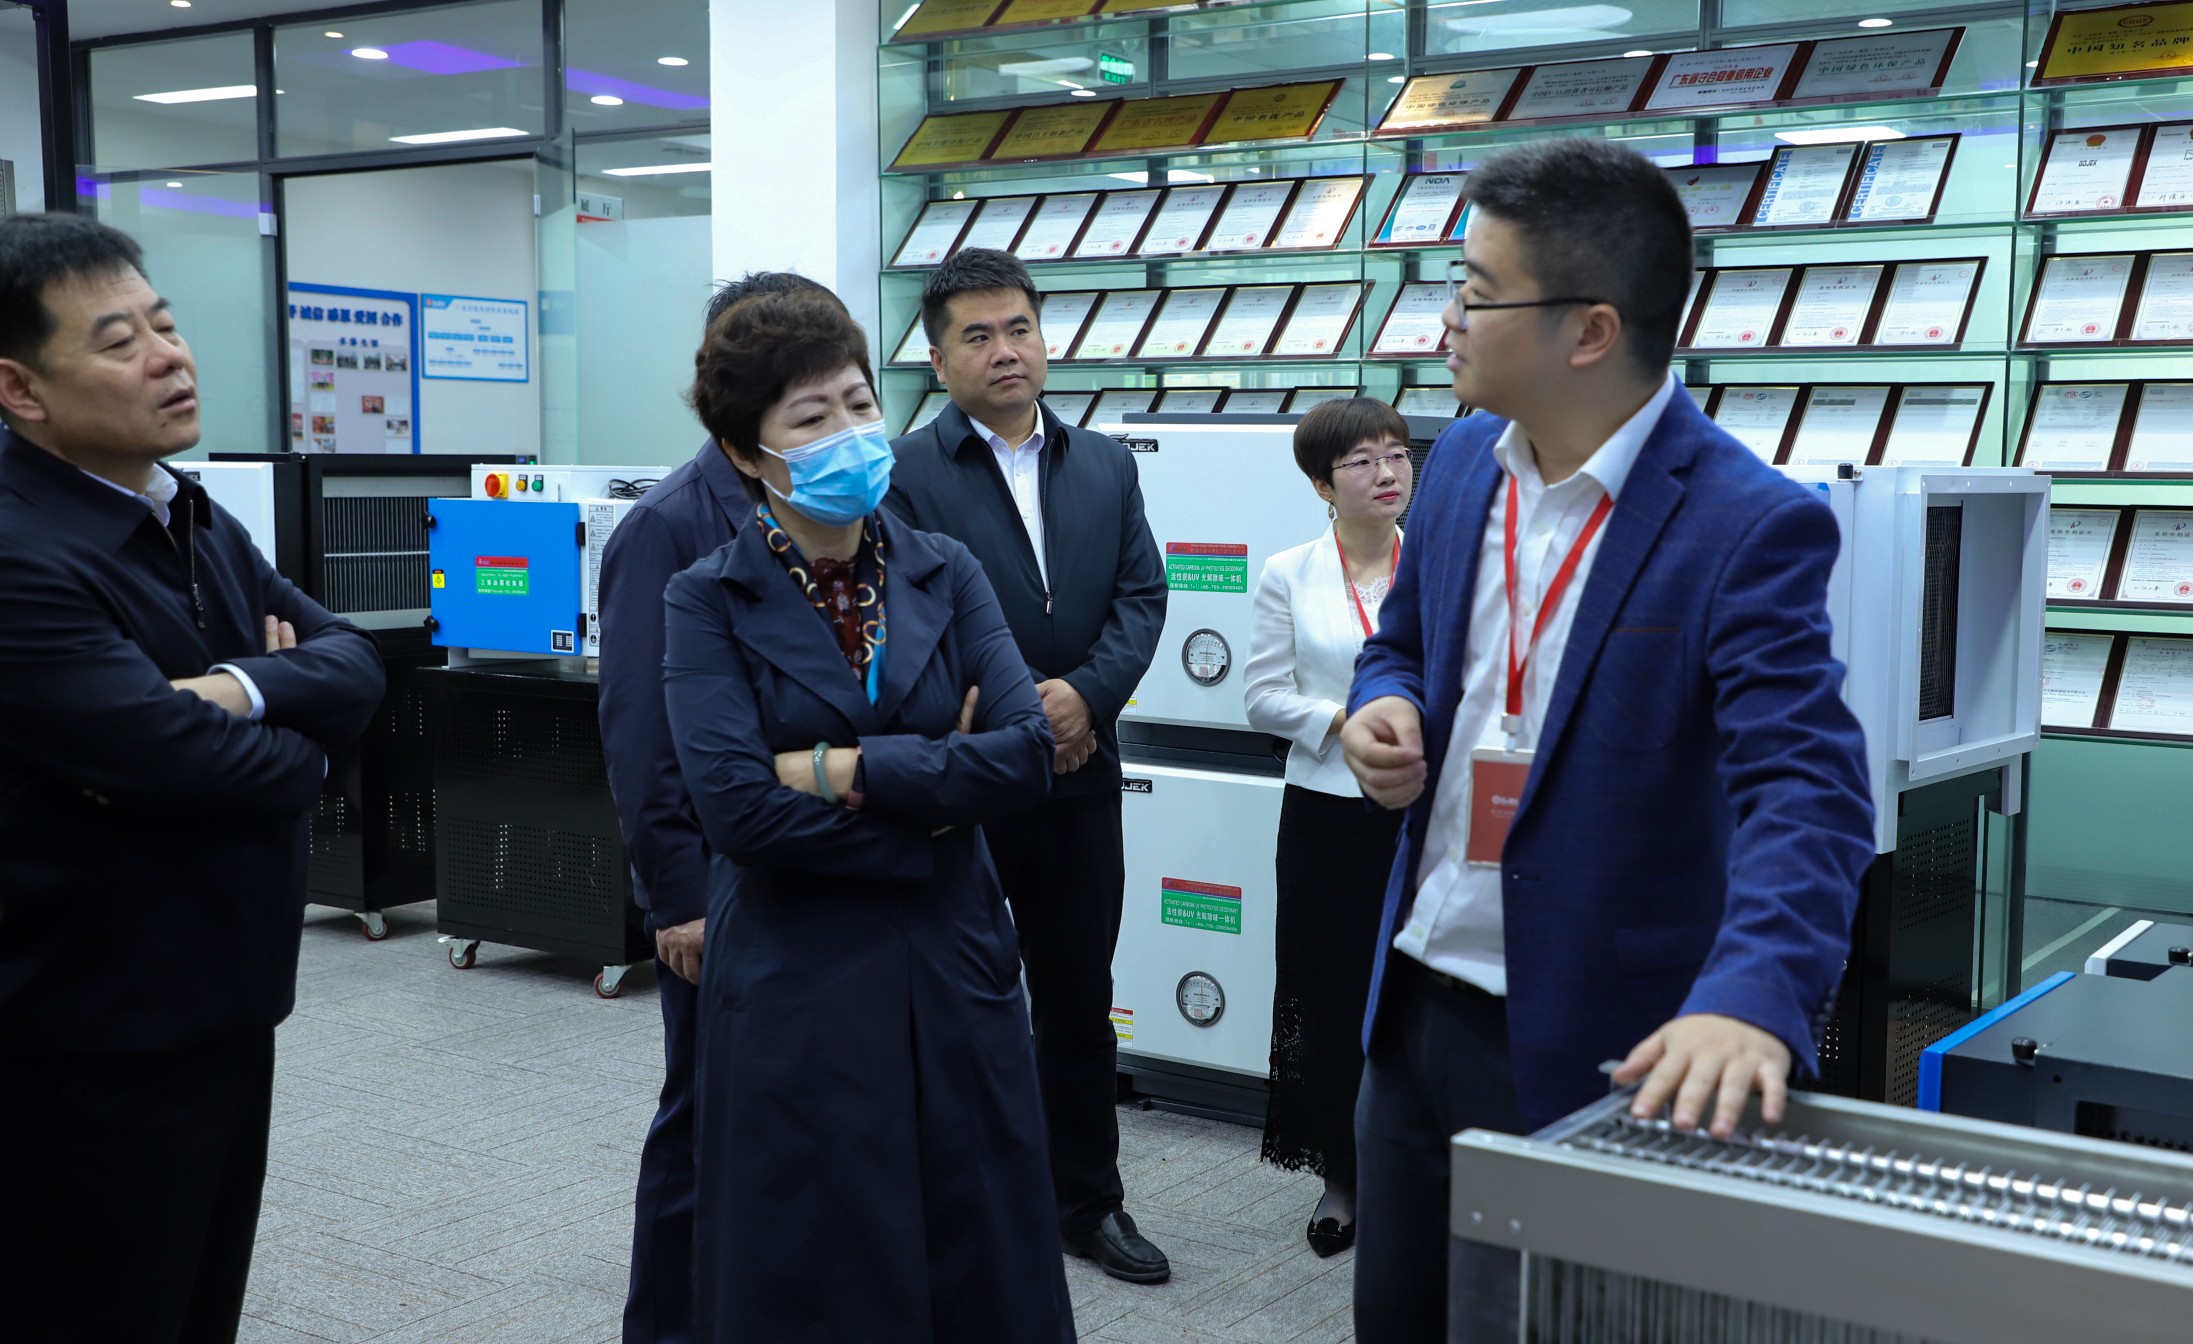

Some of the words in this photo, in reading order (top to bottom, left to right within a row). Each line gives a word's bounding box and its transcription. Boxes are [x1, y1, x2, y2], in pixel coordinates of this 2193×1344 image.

[2067, 36, 2190, 54] 中国知名品牌
[1104, 71, 1126, 85] EXIT
[1669, 67, 1774, 86] 广东省守合同重信用企业
[1757, 152, 1790, 219] CERTIFICATE
[1850, 146, 1883, 214] CERTIFICATE
[1171, 573, 1200, 581] 活性炭&UV
[1201, 573, 1242, 583] 光解除味一体机
[1166, 907, 1194, 918] 活性炭&UV
[1196, 911, 1236, 925] 光解除味一体机
